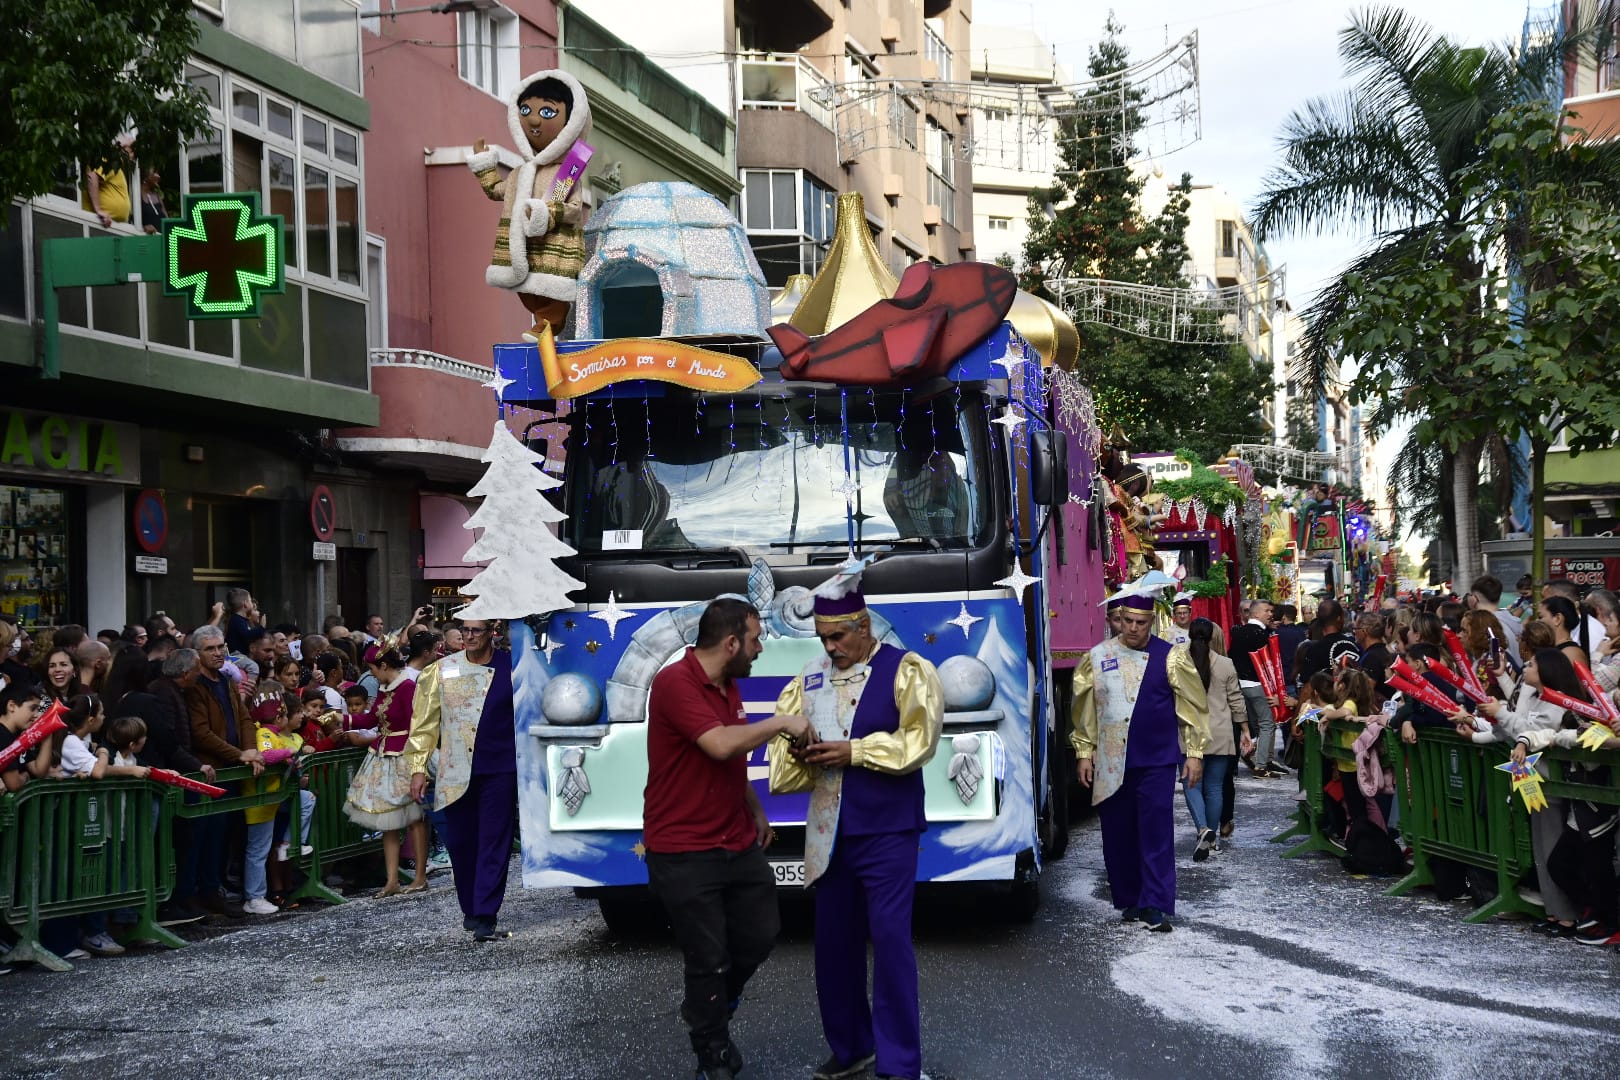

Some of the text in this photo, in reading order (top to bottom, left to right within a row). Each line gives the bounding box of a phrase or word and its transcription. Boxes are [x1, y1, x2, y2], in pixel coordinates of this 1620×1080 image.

[567, 355, 728, 382] Sonrisas por el Mundo
[1, 411, 123, 475] ACIA
[1565, 562, 1604, 570] WORLD
[1566, 571, 1605, 585] ROCK
[772, 865, 805, 882] 959
